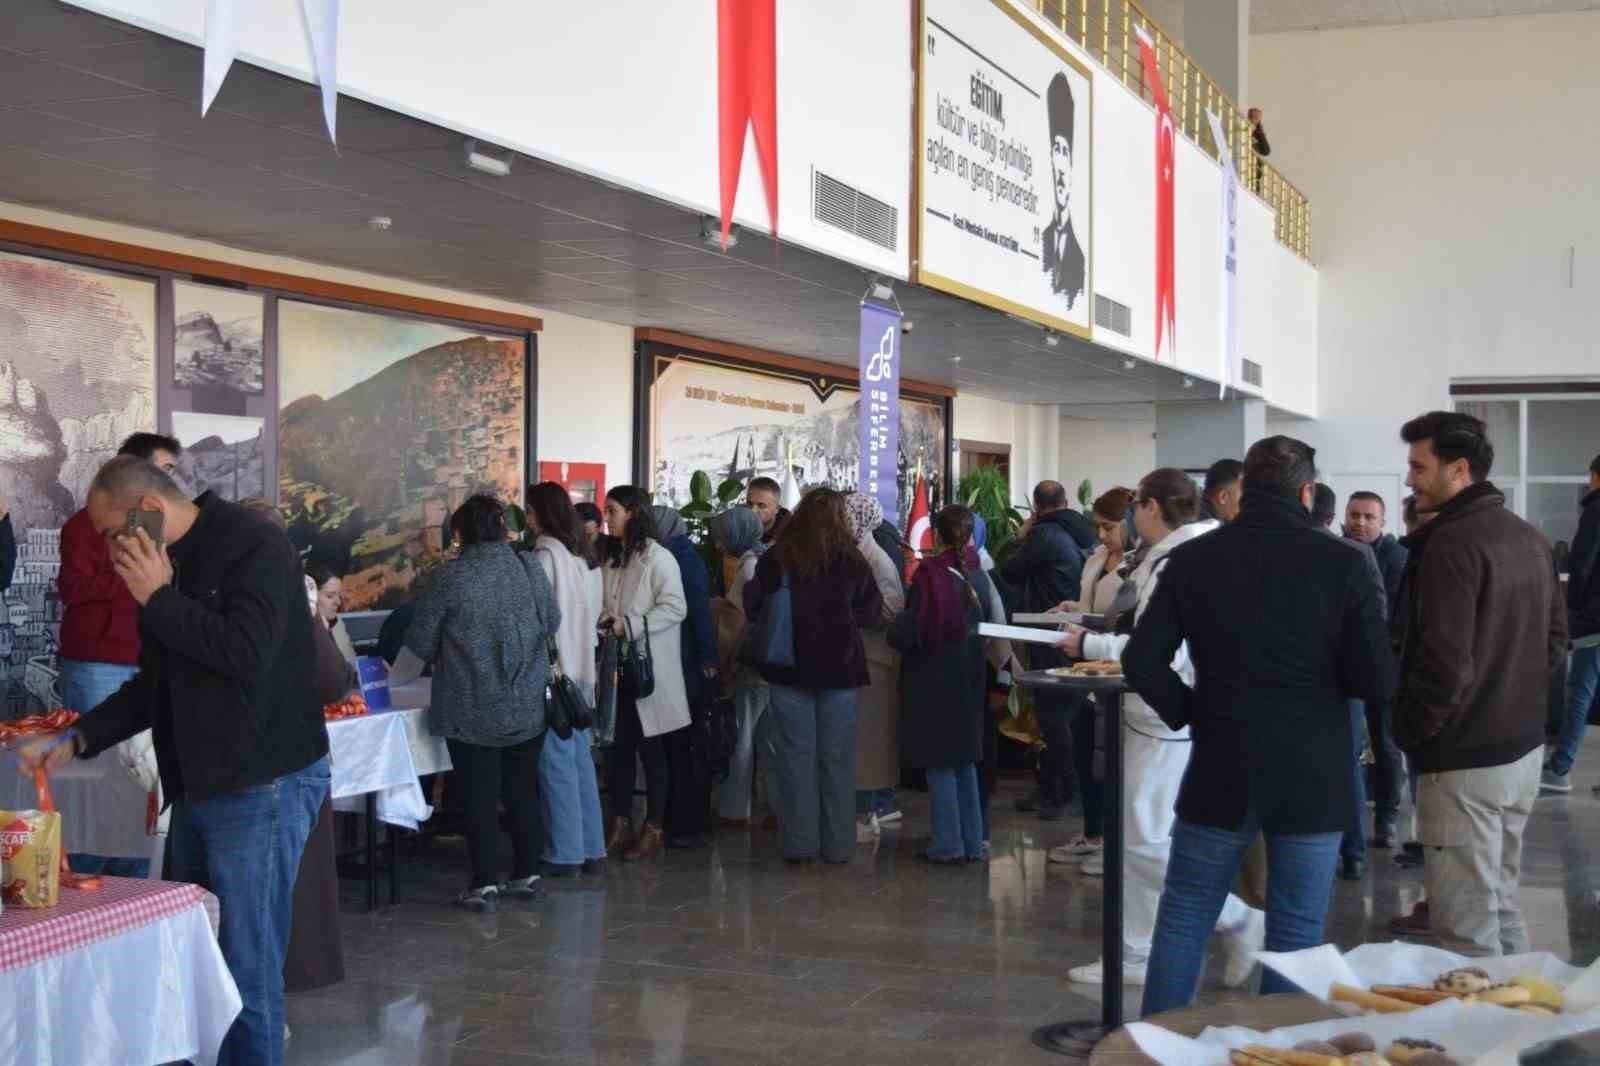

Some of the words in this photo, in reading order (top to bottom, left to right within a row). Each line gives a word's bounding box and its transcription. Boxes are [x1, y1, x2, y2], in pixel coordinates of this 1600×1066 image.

[937, 91, 965, 136] kültür
[967, 119, 978, 146] ve
[980, 119, 998, 164] bilgi
[970, 70, 1005, 131] EĞİTİM,
[927, 136, 955, 174] açılan
[957, 154, 969, 180] en
[970, 162, 994, 202] geniş
[870, 389, 880, 500] SEFERBER
[879, 391, 889, 449] BİLİM
